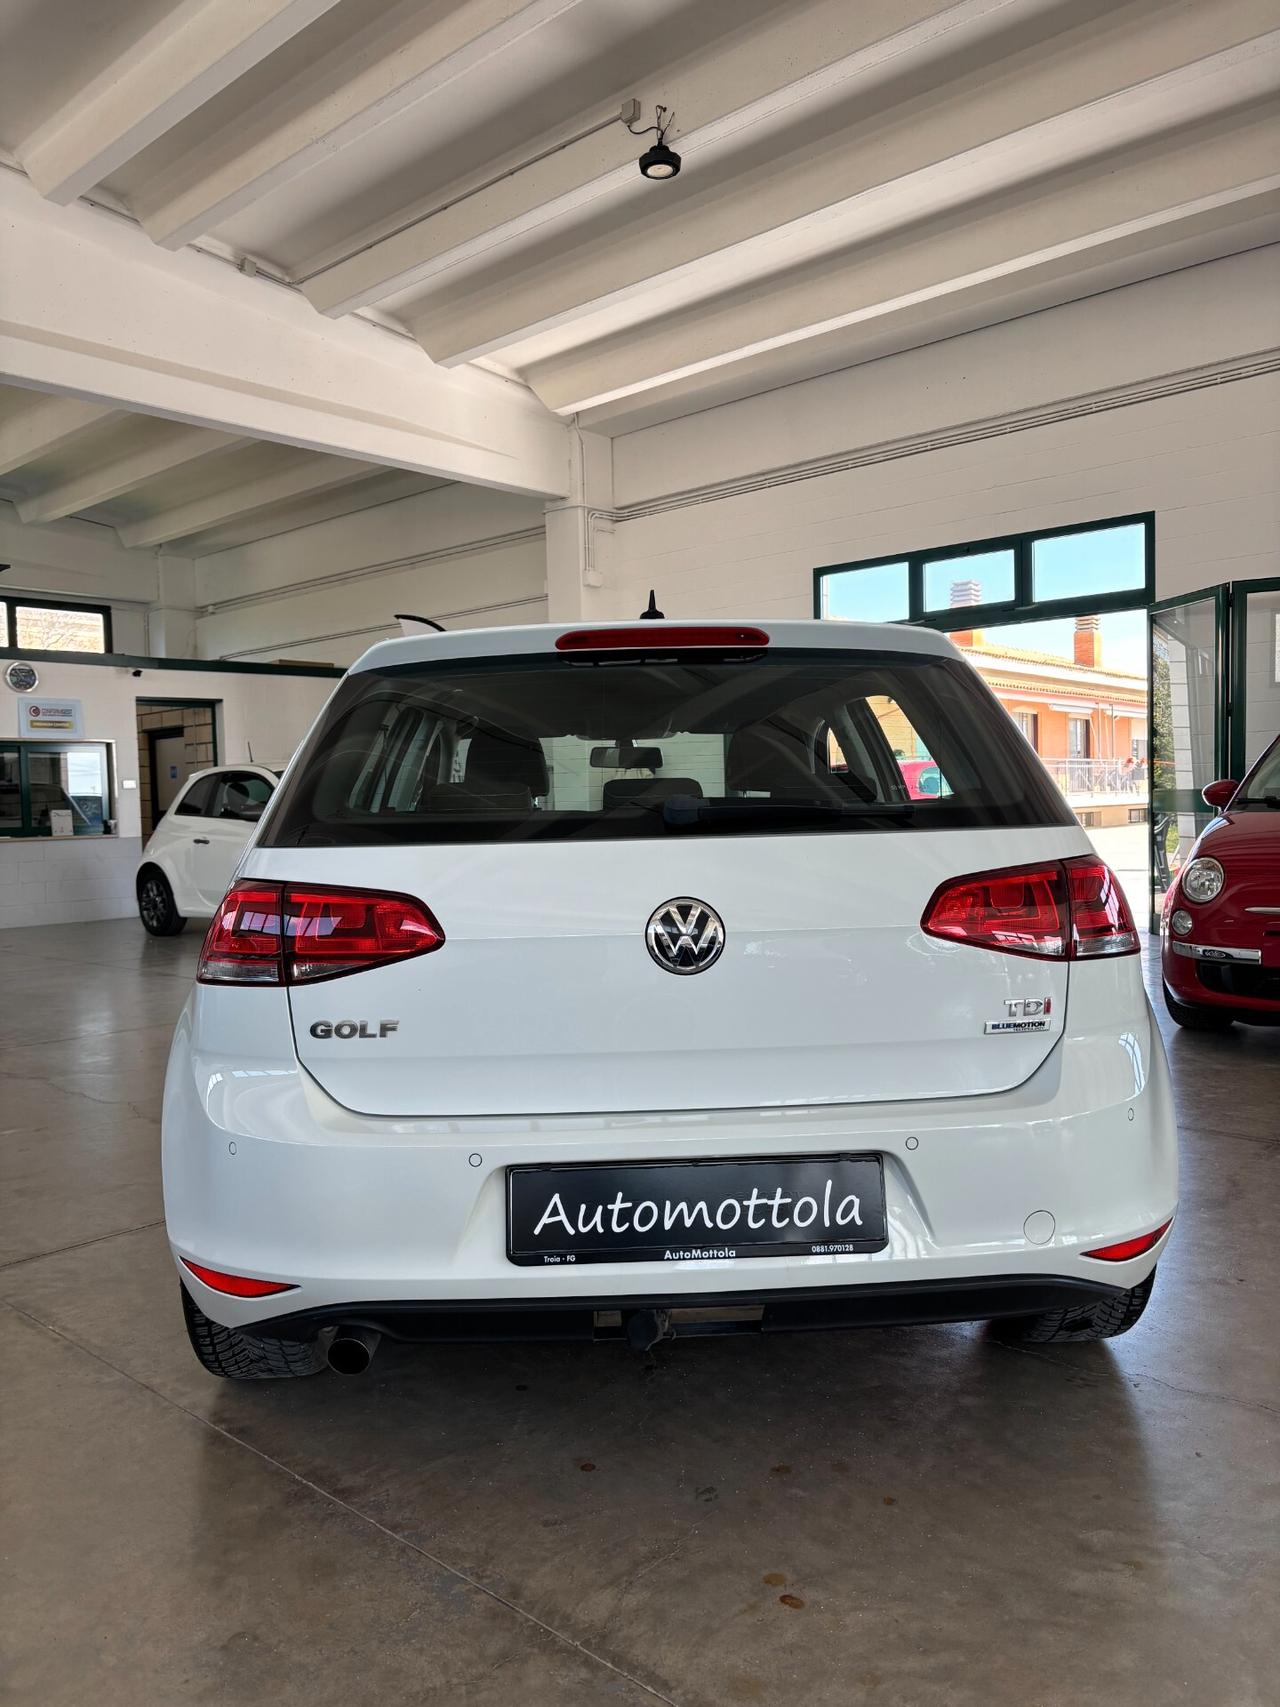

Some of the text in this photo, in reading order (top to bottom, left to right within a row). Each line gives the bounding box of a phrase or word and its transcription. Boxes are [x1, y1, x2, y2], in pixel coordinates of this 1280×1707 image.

[309, 1019, 400, 1039] GOLF
[991, 1021, 1046, 1030] BLUEMOTION
[533, 1179, 863, 1236] Automottola
[663, 1247, 737, 1261] AutoMottola
[811, 1244, 854, 1253] 0881.970128
[544, 1255, 561, 1263] Troia
[566, 1254, 576, 1262] FG
